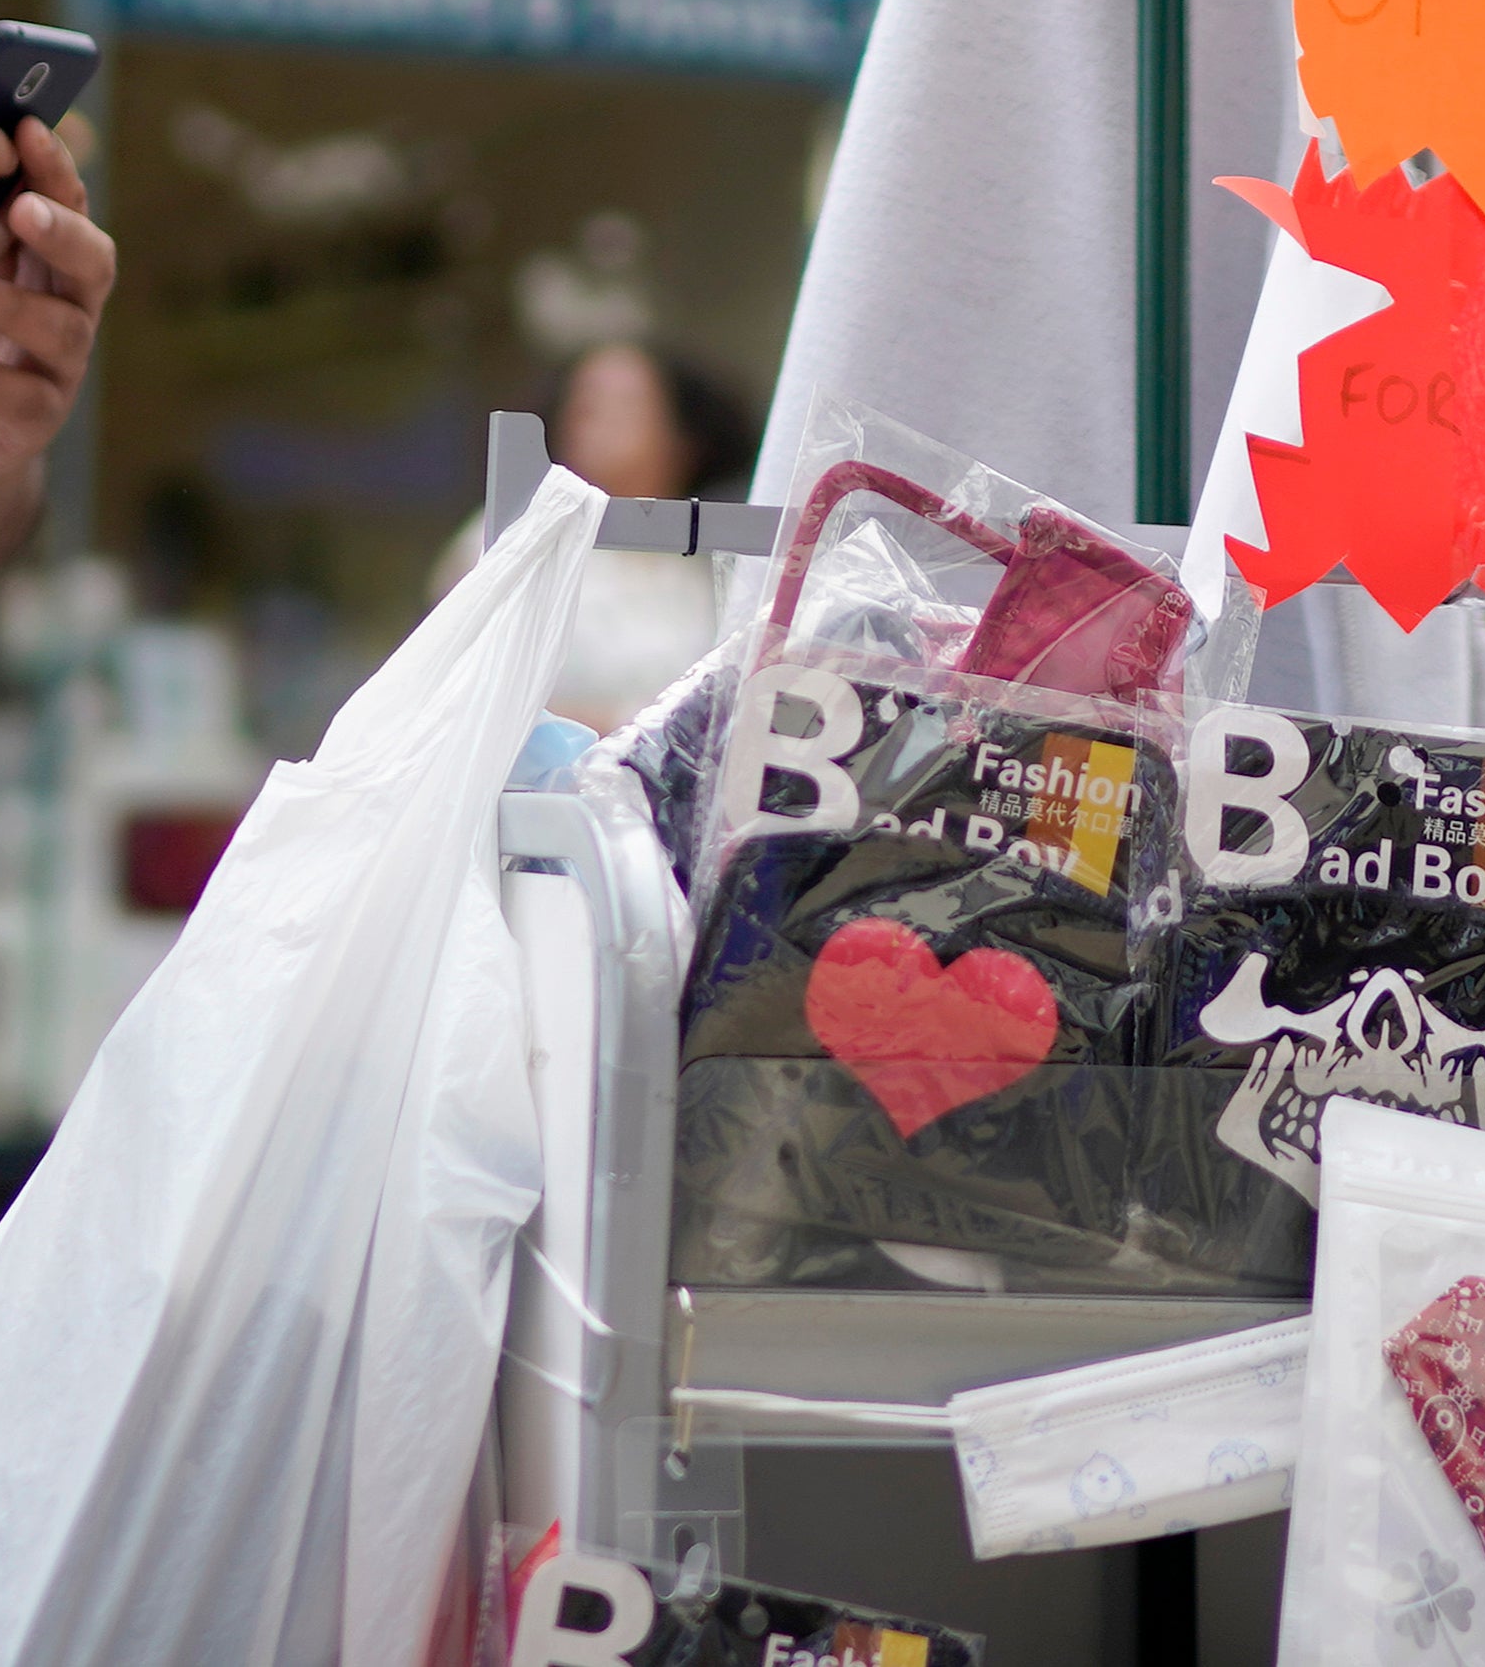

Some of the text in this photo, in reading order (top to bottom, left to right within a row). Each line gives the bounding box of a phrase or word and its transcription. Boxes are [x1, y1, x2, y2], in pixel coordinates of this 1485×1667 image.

[1339, 360, 1462, 436] FOR
[972, 742, 1143, 813] Fashion
[978, 787, 1135, 839] 精品莫代尔口罩
